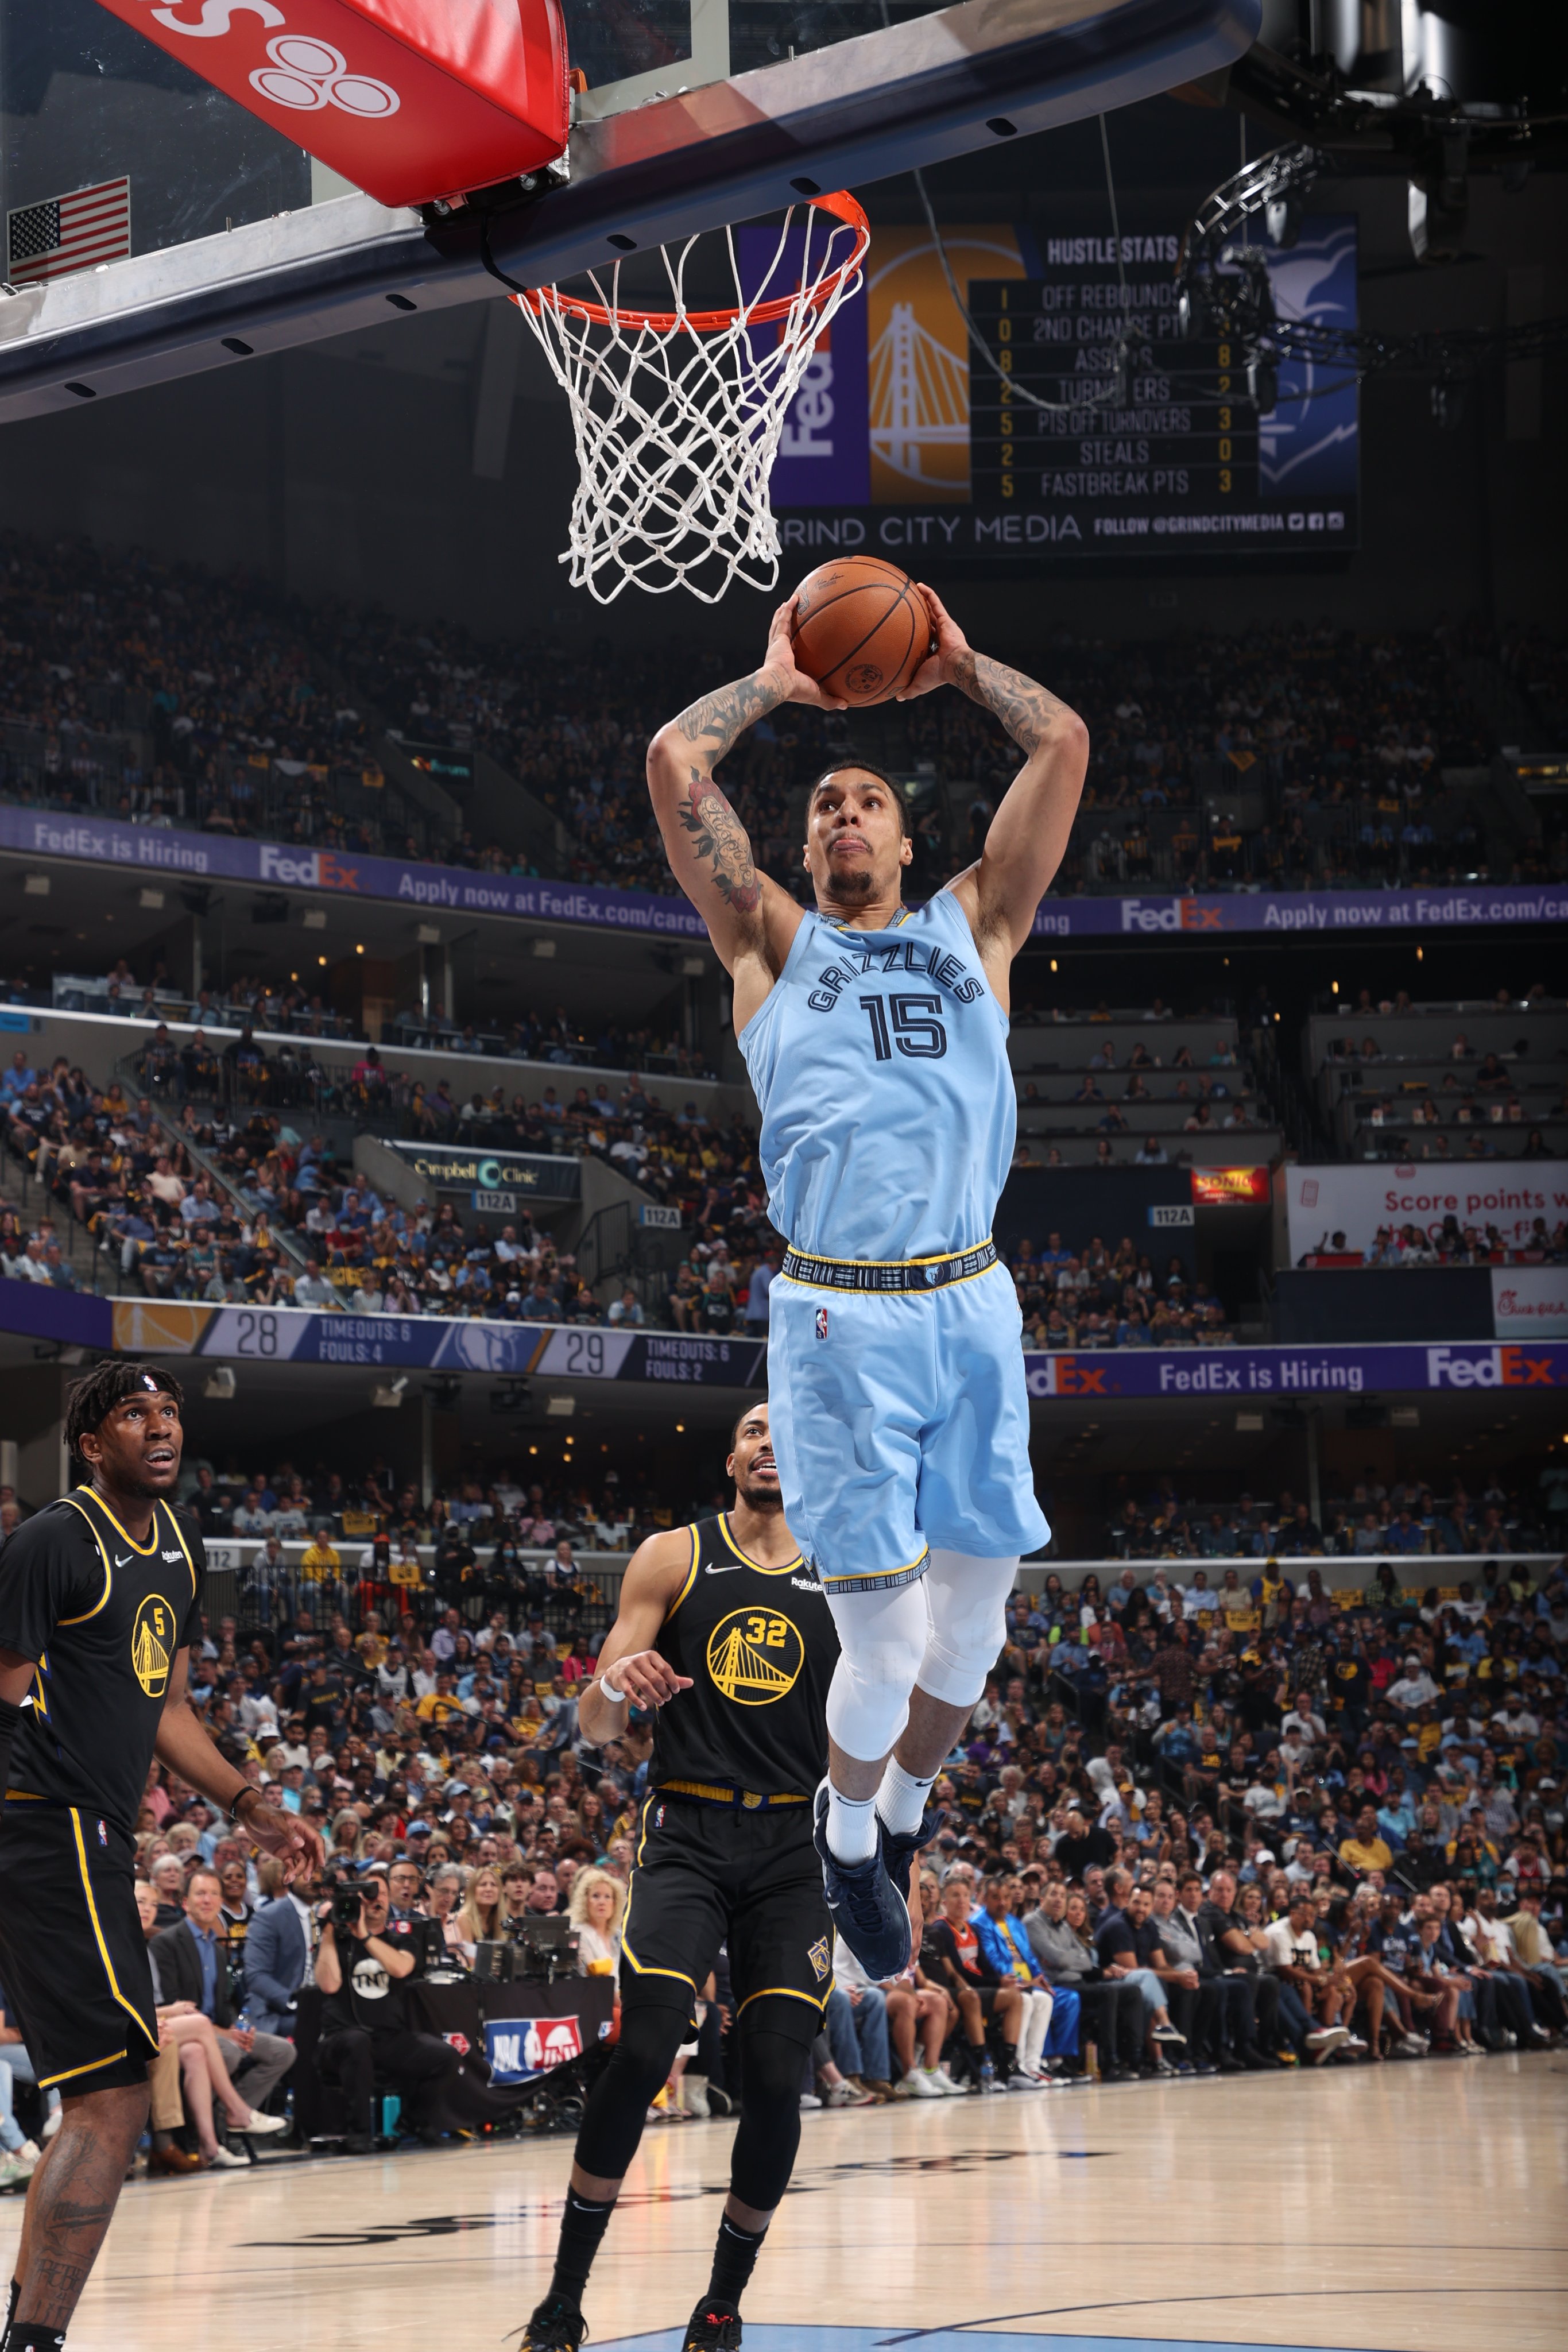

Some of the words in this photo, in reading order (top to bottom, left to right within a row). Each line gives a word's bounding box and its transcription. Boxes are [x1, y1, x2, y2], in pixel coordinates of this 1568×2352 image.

[1047, 237, 1117, 265] HUSTLE
[1121, 235, 1178, 262] STATS
[1042, 285, 1077, 311] OFF
[998, 318, 1012, 343] 0
[1033, 317, 1072, 342] 2ND
[1157, 314, 1184, 339] PT
[1218, 343, 1232, 368] 8
[1058, 376, 1171, 403] TURNERS
[1000, 411, 1013, 435] 5
[1037, 411, 1067, 435] PTS
[1070, 409, 1097, 434] OFF
[1101, 407, 1191, 434] TURNOVERS
[1218, 406, 1232, 431] 3
[1001, 443, 1013, 467] 2
[1080, 439, 1149, 466] STEALS
[1218, 437, 1232, 462] 0
[1001, 474, 1014, 498] 5
[1041, 470, 1149, 497] FASTBREAK
[1153, 469, 1189, 495] PTS
[1218, 469, 1232, 493] 3
[880, 516, 961, 546] CITY
[975, 514, 1082, 543] MEDIA
[1093, 517, 1151, 536] FOLLOW
[1152, 513, 1285, 535] @GRINDCITYMEDIA
[34, 823, 105, 856] FedEx
[114, 835, 132, 859] is
[138, 838, 208, 873] Hiring
[260, 845, 359, 889] FedEx
[398, 873, 459, 907] Apply
[464, 887, 510, 909] now
[514, 888, 535, 912] at
[1121, 898, 1223, 931] FedEx
[1265, 903, 1327, 930] Apply
[1334, 904, 1383, 924] now
[1389, 903, 1410, 922] at
[807, 942, 985, 1013] GRIZZLIES
[859, 993, 947, 1061] 15
[502, 1166, 538, 1185] Clinic
[477, 1192, 514, 1210] 112A
[1385, 1190, 1458, 1212] Score
[1467, 1187, 1546, 1216] points
[645, 1207, 680, 1225] 112A
[1156, 1209, 1191, 1224] 112A
[237, 1313, 277, 1356] 28
[321, 1317, 398, 1342] TIMEOUTS:
[401, 1322, 411, 1343] 6
[319, 1341, 369, 1362] FOULS:
[371, 1343, 382, 1362] 4
[567, 1332, 605, 1375] 29
[646, 1338, 718, 1361] TIMEOUTS:
[720, 1344, 730, 1361] 6
[646, 1359, 691, 1380] FOULS:
[693, 1365, 702, 1381] 2
[1024, 1356, 1107, 1396] dEx
[1159, 1361, 1242, 1391] FedEx
[1249, 1361, 1273, 1388] is
[1280, 1359, 1364, 1391] Hiring
[1426, 1345, 1556, 1388] FedEx
[161, 1550, 184, 1561] Rakuten
[791, 1577, 823, 1592] Rakute
[153, 1608, 165, 1636] 5
[745, 1616, 788, 1648] 32
